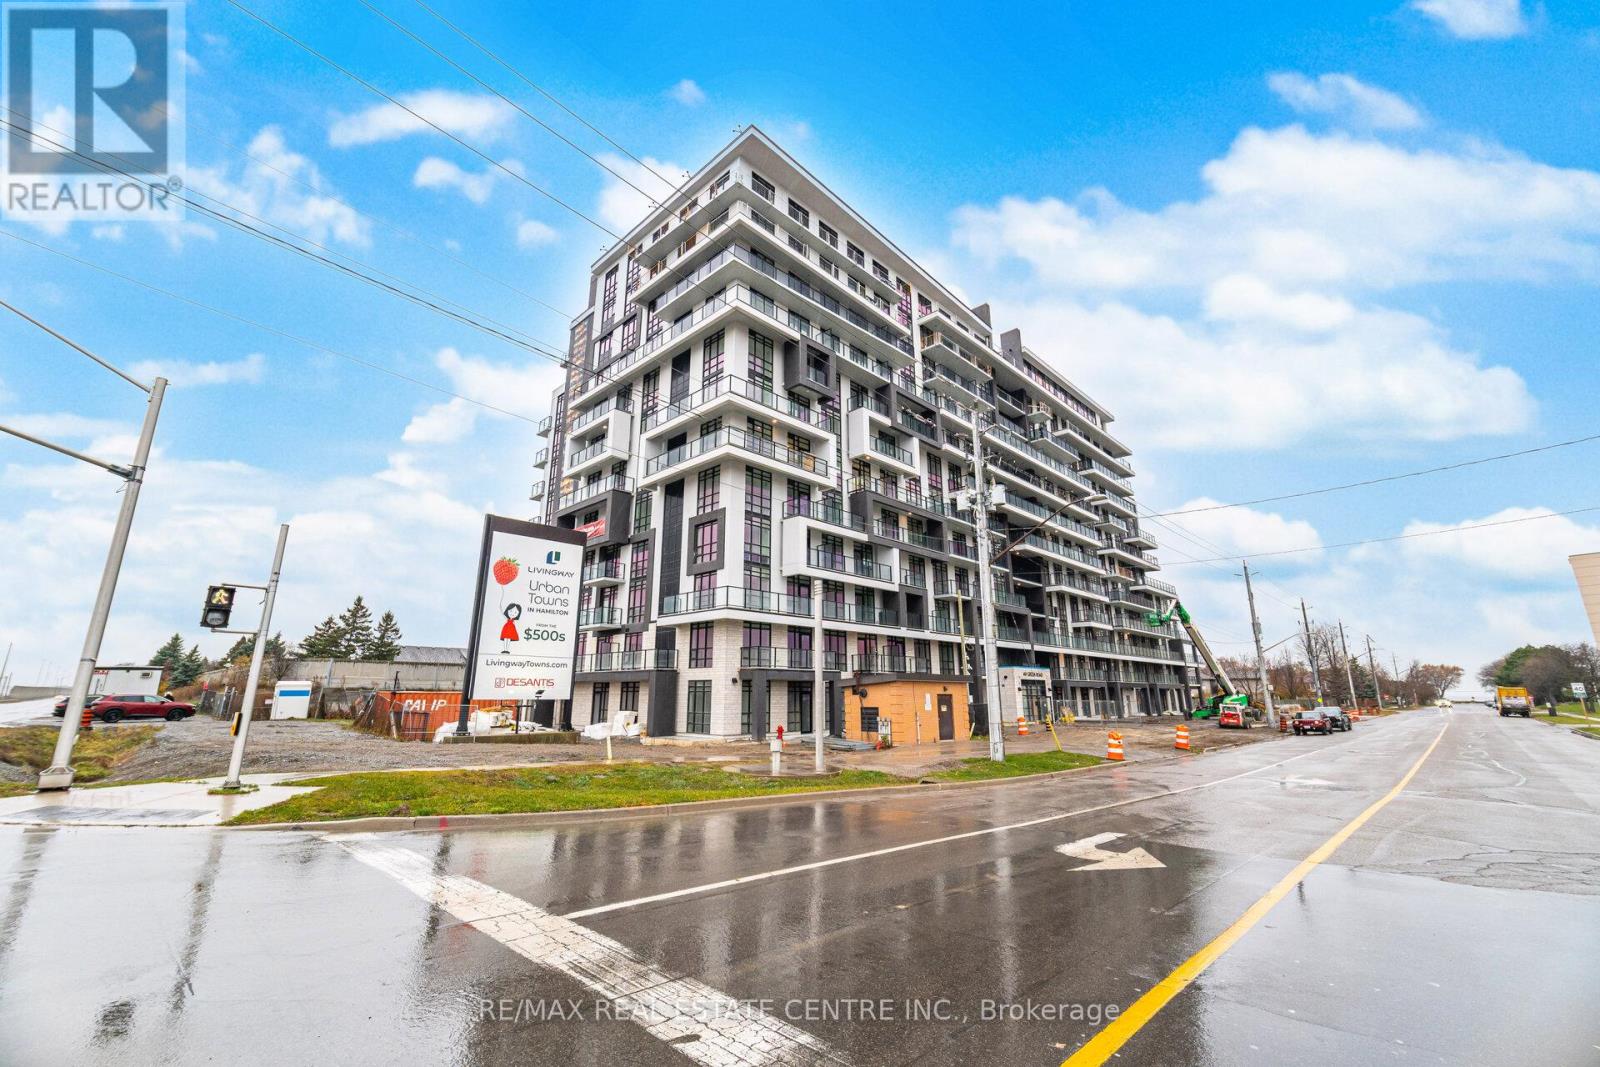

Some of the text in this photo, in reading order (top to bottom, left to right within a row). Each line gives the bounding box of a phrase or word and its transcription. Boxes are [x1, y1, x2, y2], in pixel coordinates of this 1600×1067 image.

[528, 566, 575, 578] LIVINGWAY
[529, 580, 570, 594] Urban
[528, 593, 569, 607] Towns
[536, 608, 569, 616] HAMILTON
[523, 627, 566, 642] $500s
[485, 659, 568, 669] LivingwayTowns.com
[506, 678, 555, 687] DESANTIS
